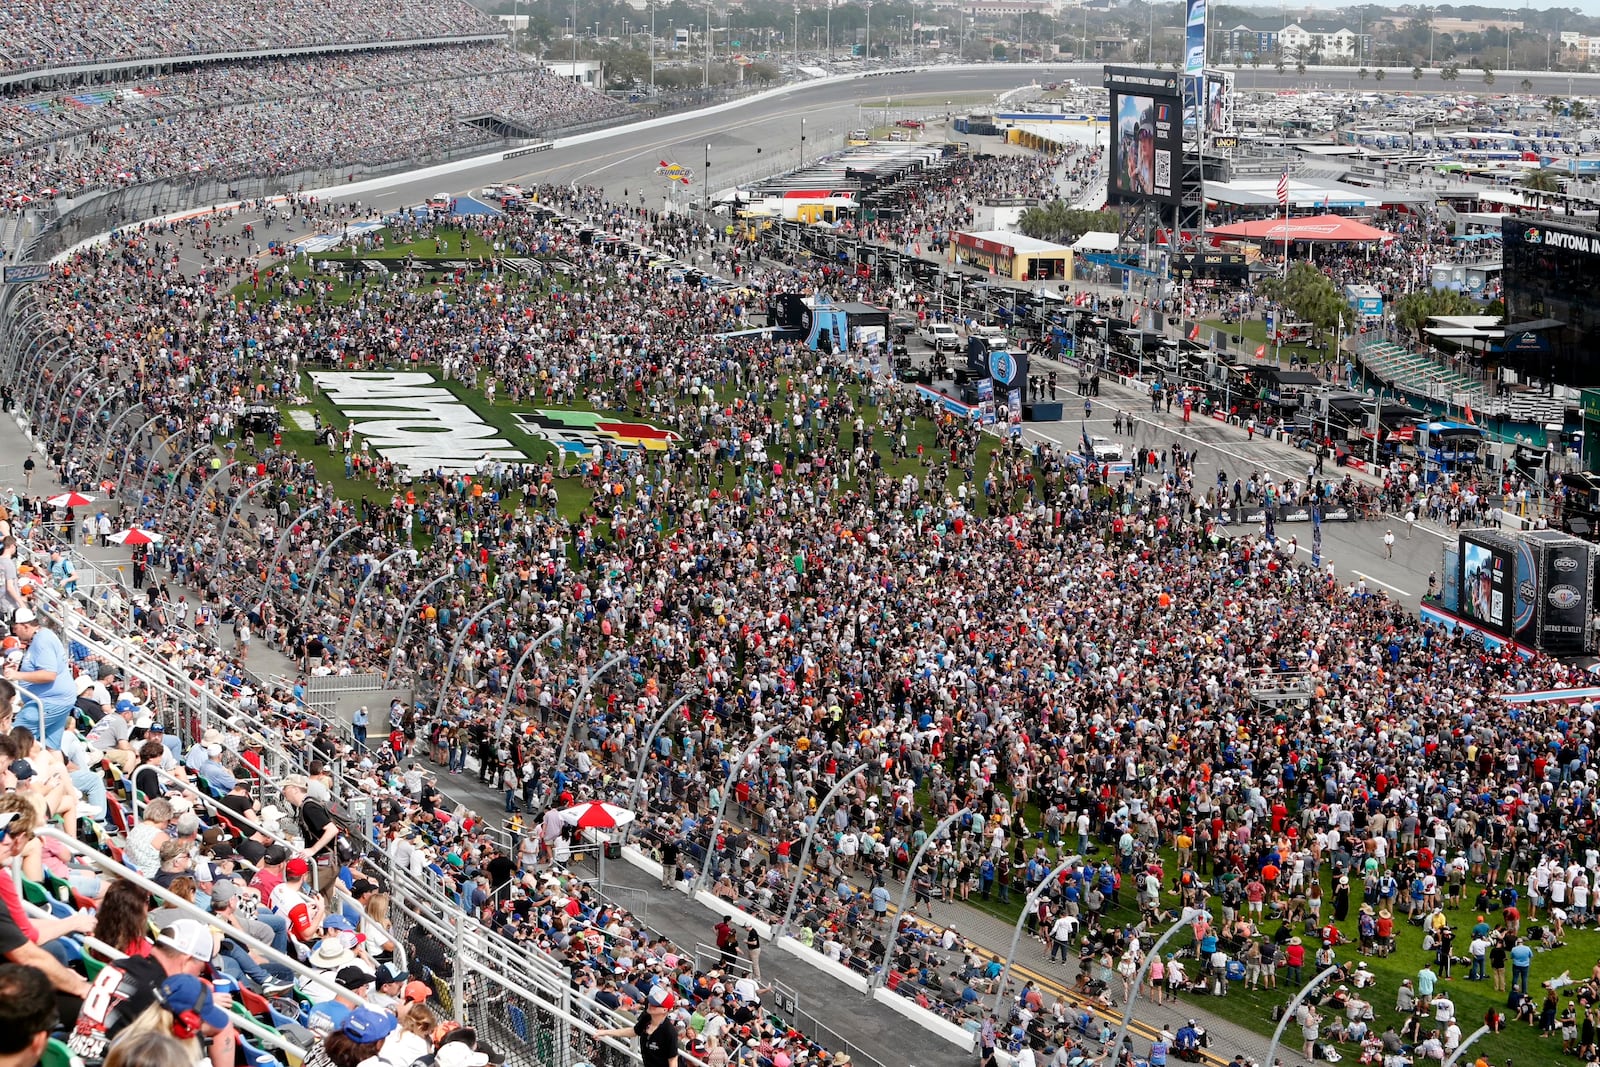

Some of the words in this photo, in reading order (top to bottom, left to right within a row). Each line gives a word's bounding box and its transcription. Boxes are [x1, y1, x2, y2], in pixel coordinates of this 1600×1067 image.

[1216, 139, 1236, 147] UNOH
[656, 169, 690, 177] SUNOCO
[1544, 230, 1590, 252] DAYTONA
[1521, 587, 1535, 598] 500
[1471, 634, 1484, 644] 500
[83, 964, 124, 1024] 8
